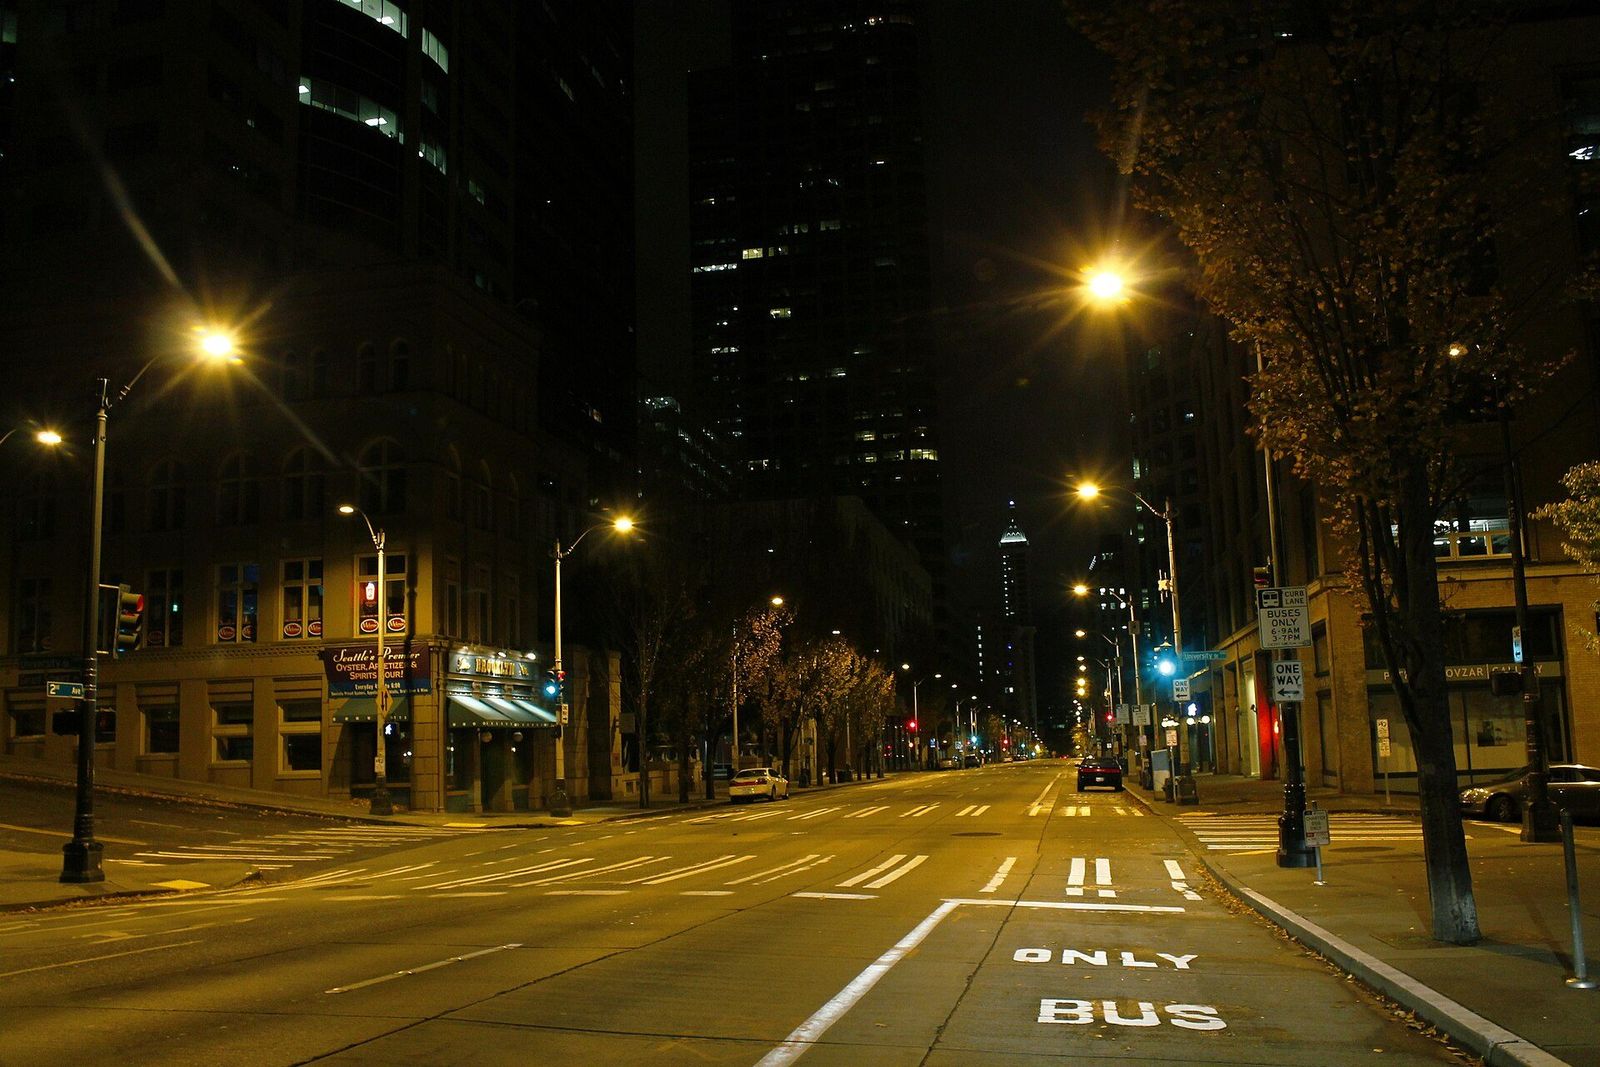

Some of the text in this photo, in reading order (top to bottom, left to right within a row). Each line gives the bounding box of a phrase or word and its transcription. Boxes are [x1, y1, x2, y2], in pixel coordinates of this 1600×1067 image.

[1268, 609, 1300, 618] BUSES
[1272, 618, 1297, 627] ONLY
[333, 649, 375, 662] Seattle's
[1276, 664, 1300, 674] ONE
[350, 670, 403, 680] SPIRITS OUR!
[1276, 676, 1300, 685] WAY
[1013, 948, 1198, 969] ONLY
[1038, 999, 1227, 1030] BUS
